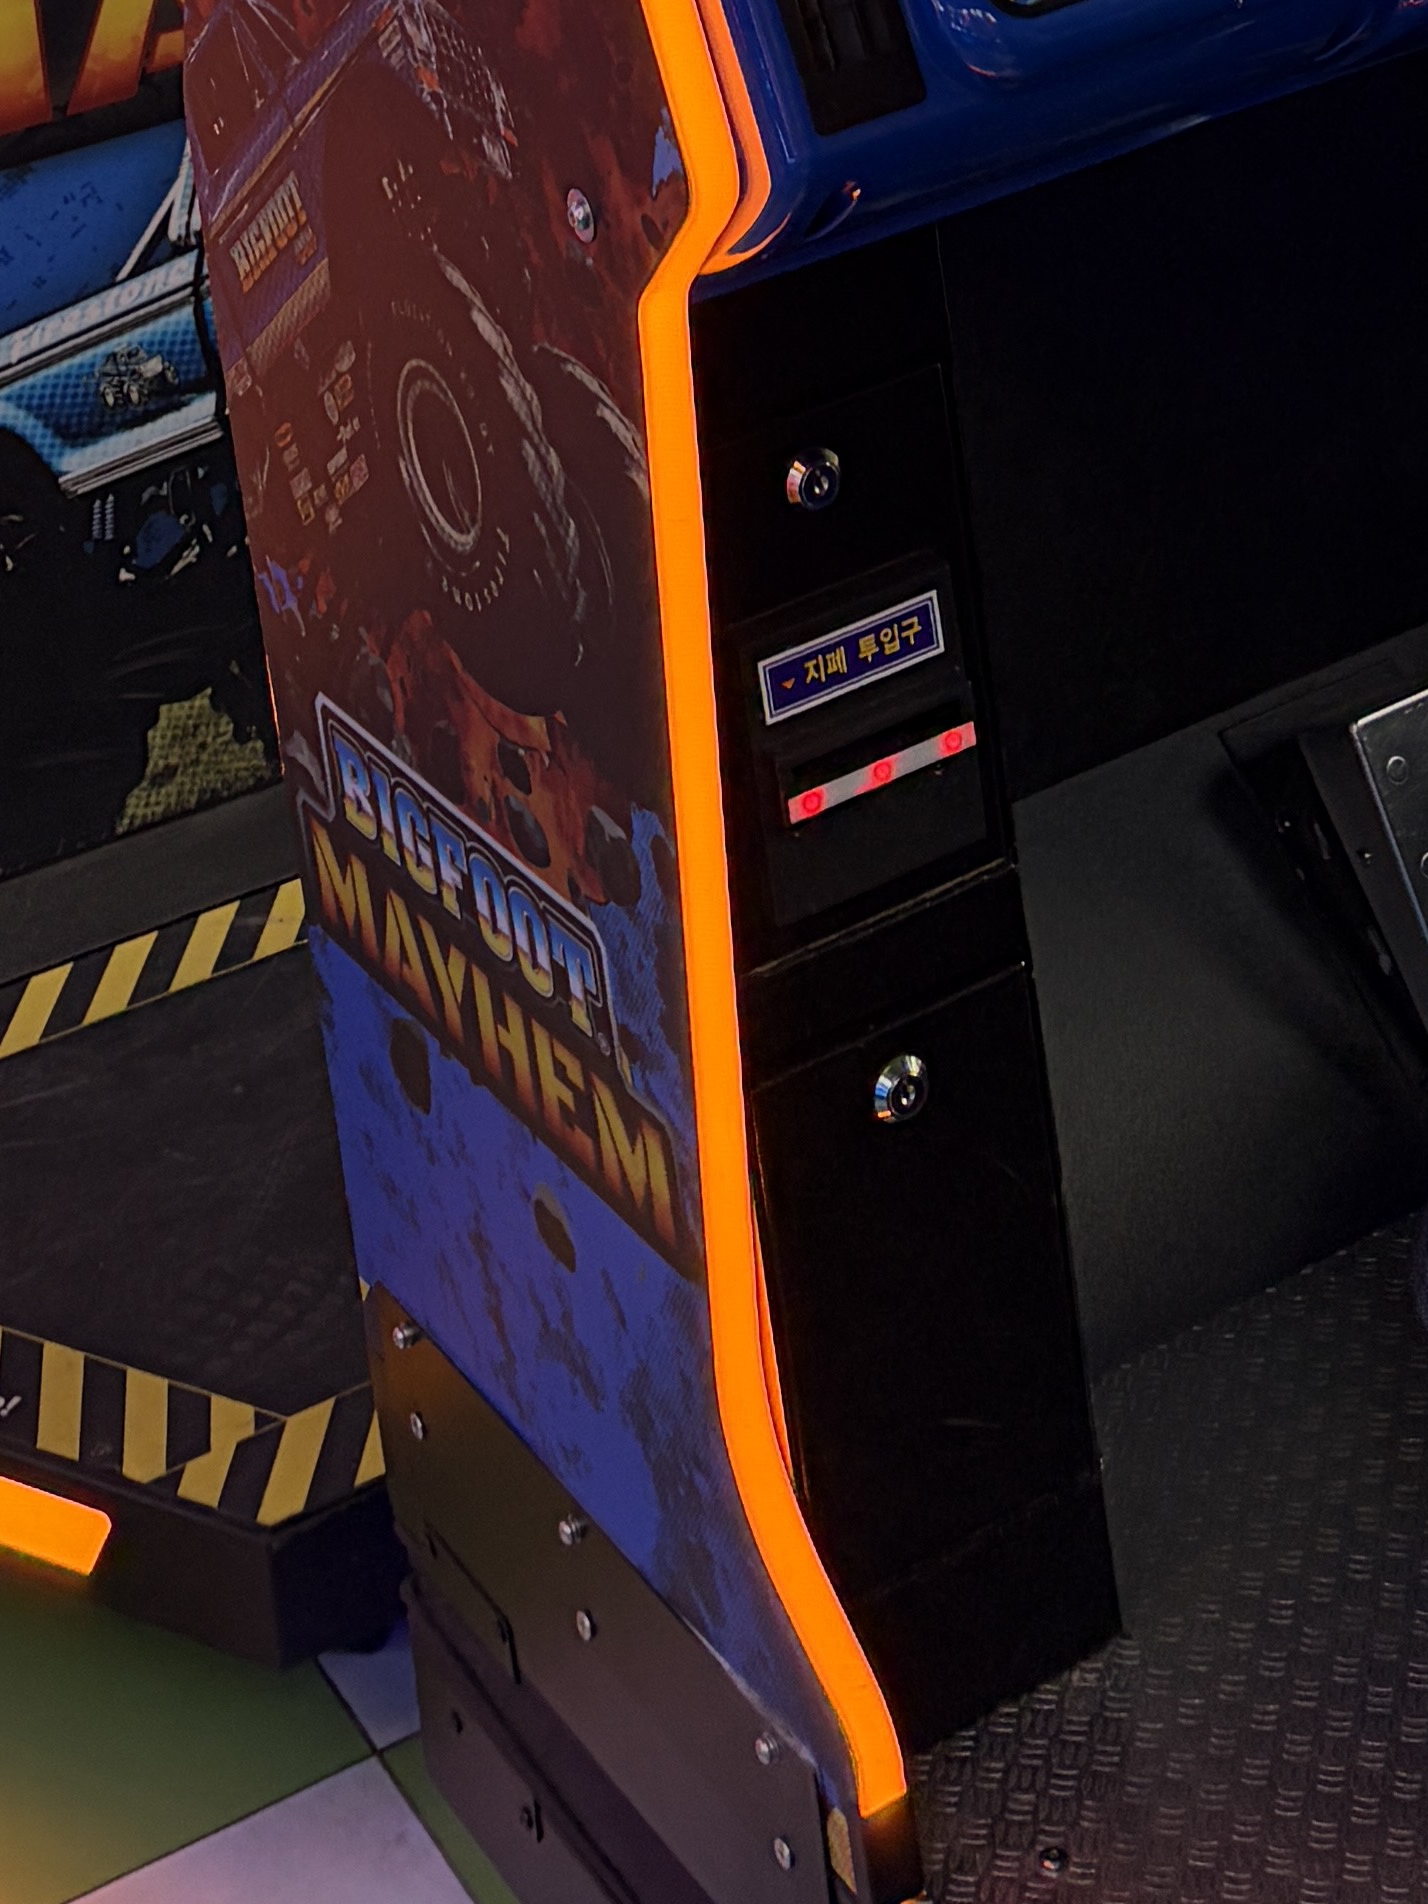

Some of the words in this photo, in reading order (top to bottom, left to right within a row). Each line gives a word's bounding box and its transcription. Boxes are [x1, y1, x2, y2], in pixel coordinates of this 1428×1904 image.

[802, 649, 849, 687] 지폐
[857, 613, 924, 665] 투입구
[310, 816, 676, 1248] MAYHEM
[332, 727, 608, 1040] BIGFOOT
